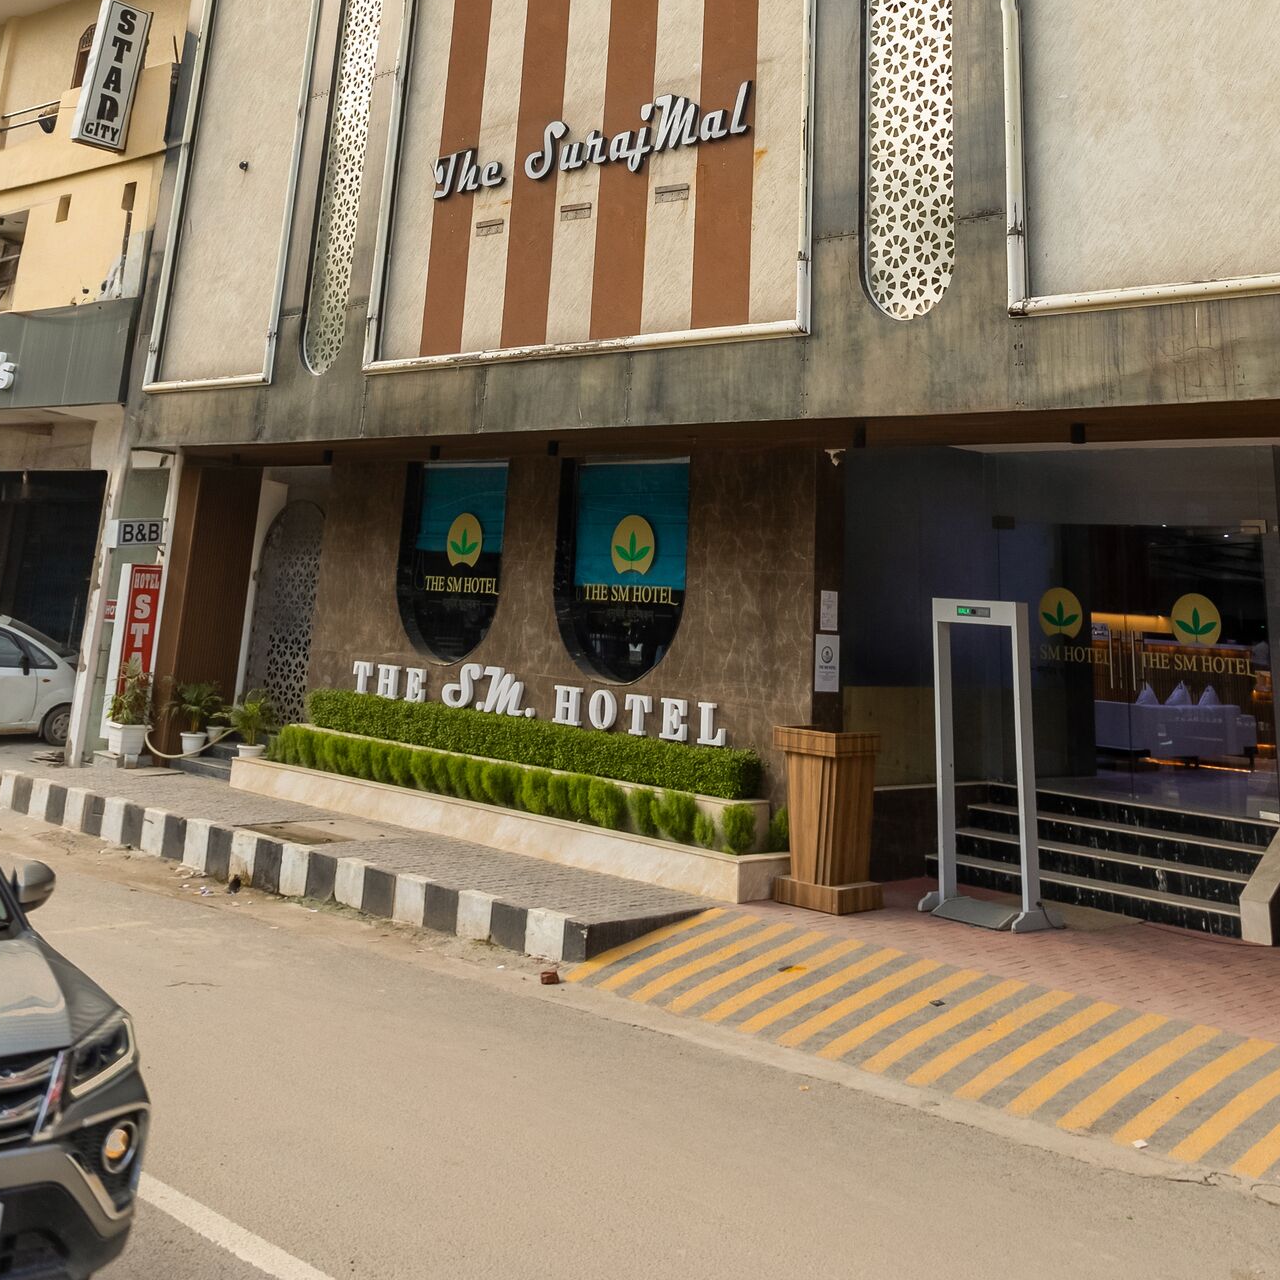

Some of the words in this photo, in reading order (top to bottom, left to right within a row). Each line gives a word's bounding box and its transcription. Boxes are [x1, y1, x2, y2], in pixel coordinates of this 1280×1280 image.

[85, 122, 119, 142] CITY
[433, 148, 505, 199] The
[122, 522, 160, 542] B&B
[134, 572, 160, 590] HOTEL
[425, 576, 445, 591] THE
[447, 577, 462, 593] SM
[464, 577, 499, 595] HOTEL
[583, 584, 608, 600] THE
[611, 585, 629, 602] SM
[632, 585, 679, 606] HOTEL
[1040, 646, 1062, 661] SM
[1064, 646, 1111, 665] HOTEL
[1141, 652, 1170, 669] THE
[1174, 654, 1198, 671] SM
[1201, 657, 1257, 678] HOTEL
[353, 661, 427, 702] THE
[552, 684, 727, 747] HOTEL
